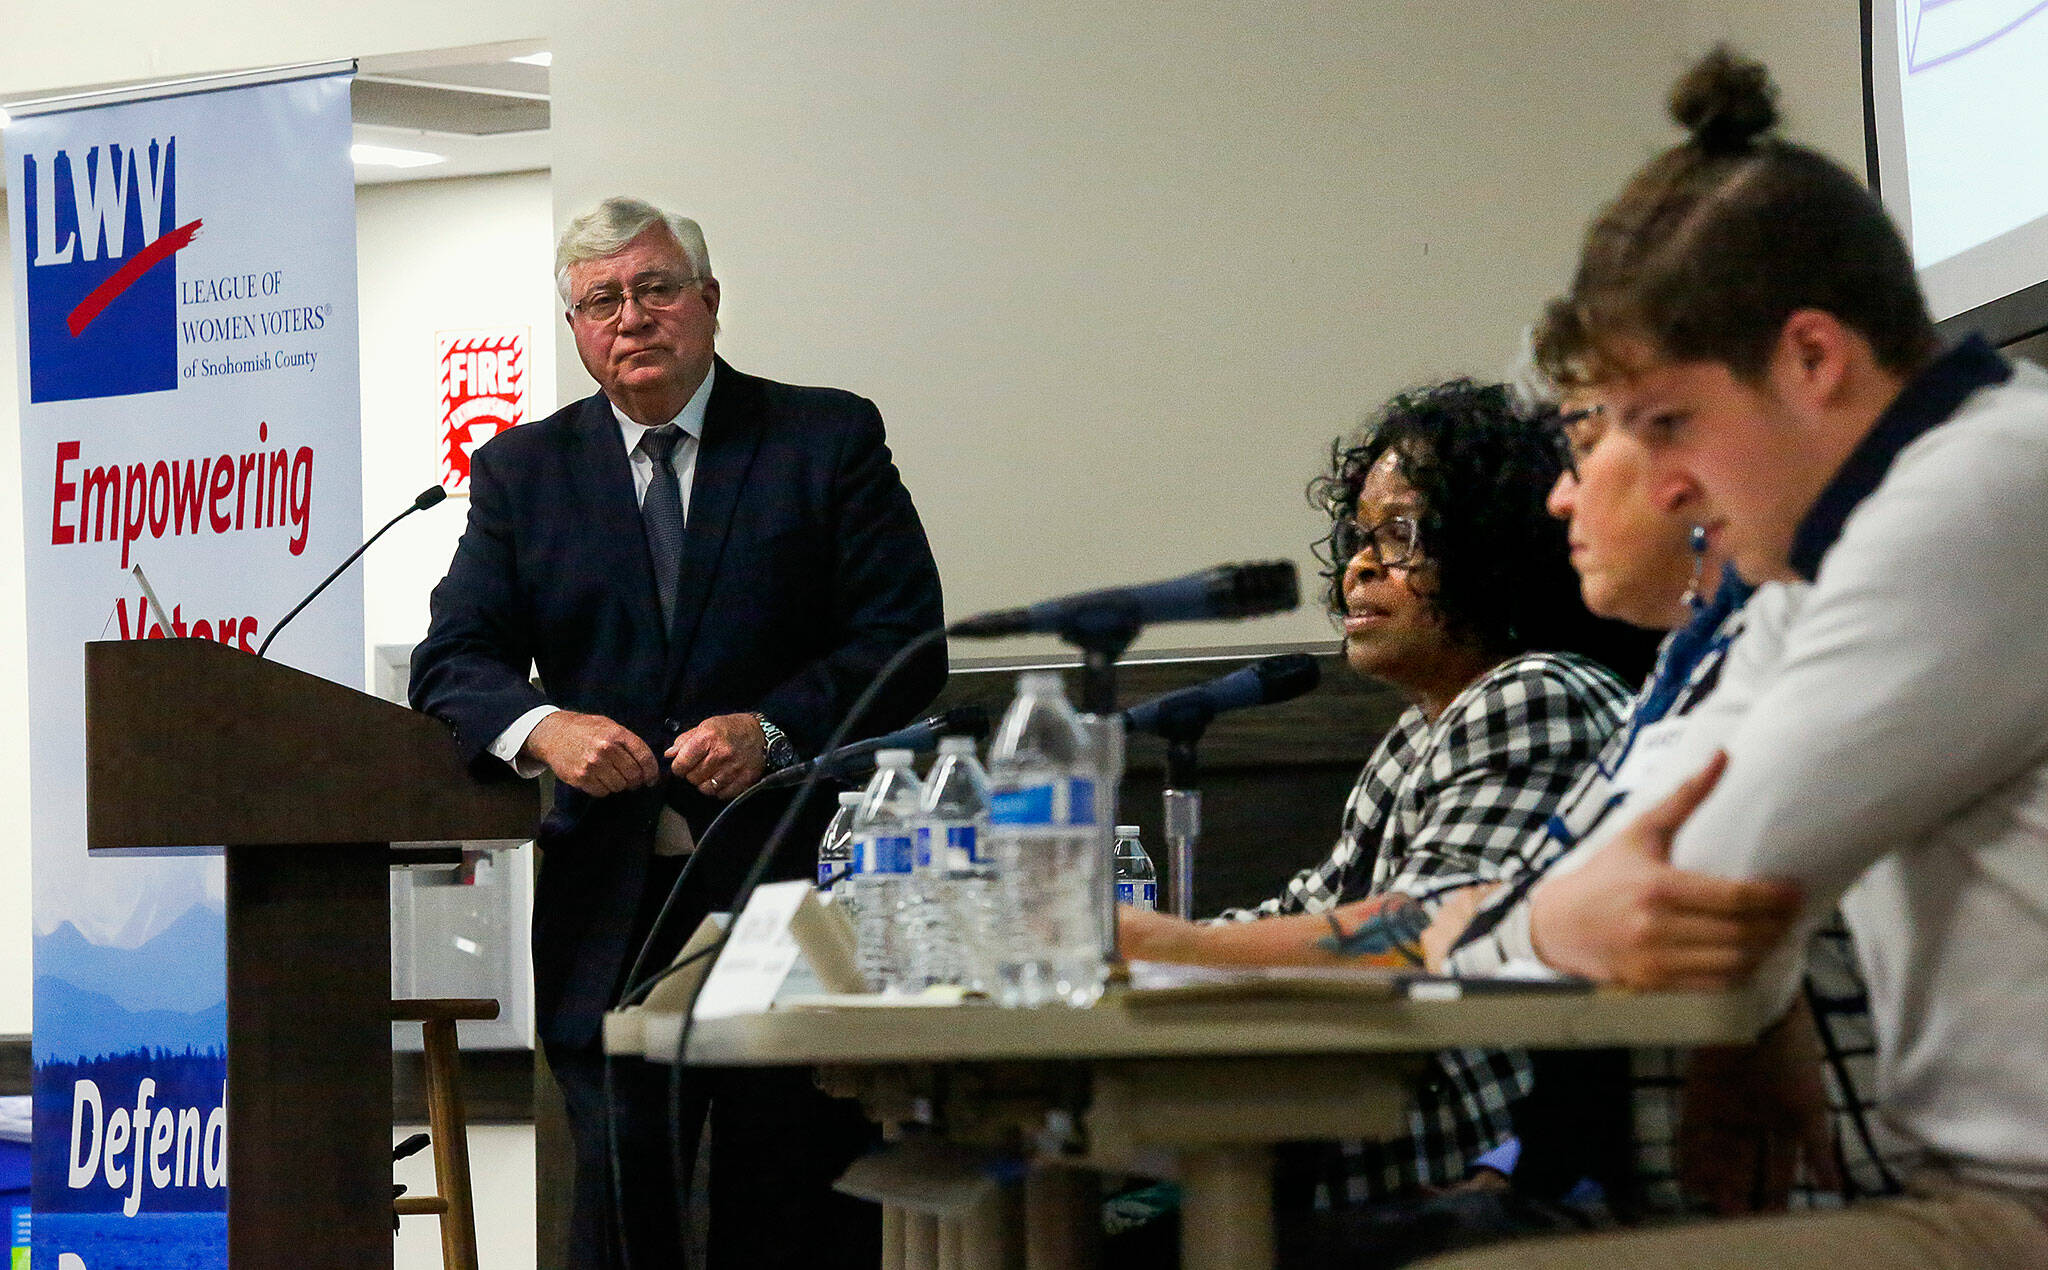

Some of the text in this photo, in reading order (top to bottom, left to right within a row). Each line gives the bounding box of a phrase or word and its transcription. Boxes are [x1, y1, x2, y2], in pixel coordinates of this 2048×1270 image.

[25, 136, 175, 267] LWV
[182, 270, 283, 305] LEAGUE OF
[182, 313, 256, 345] WOMEN
[183, 350, 318, 379] of Snohomish County
[449, 348, 515, 398] FIRE
[51, 420, 314, 569] Empowering
